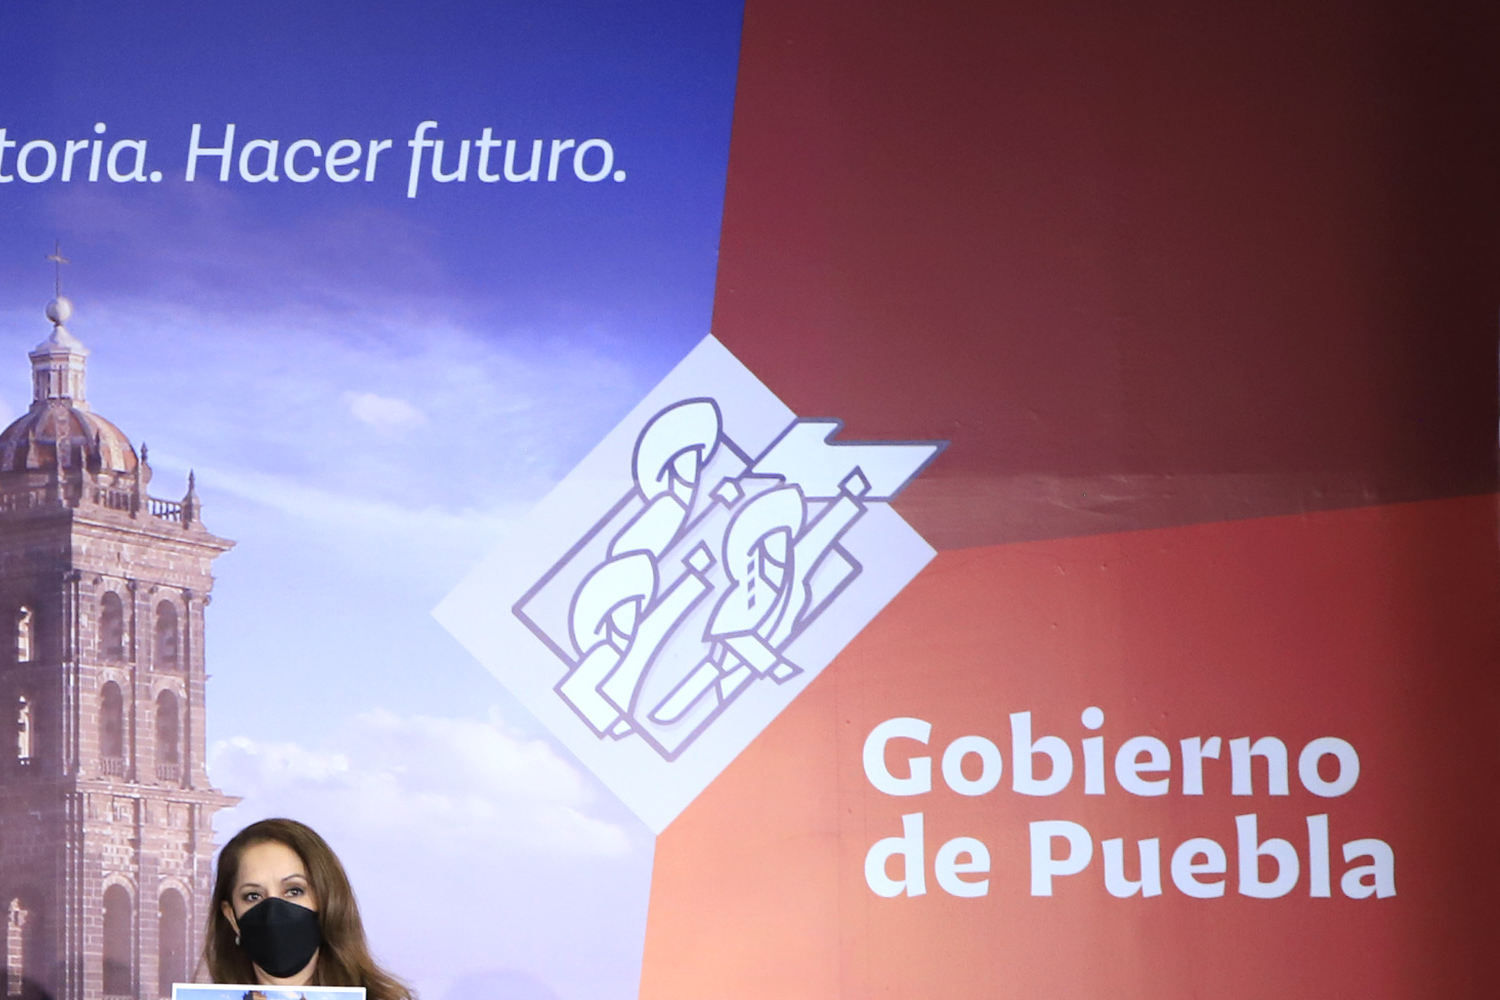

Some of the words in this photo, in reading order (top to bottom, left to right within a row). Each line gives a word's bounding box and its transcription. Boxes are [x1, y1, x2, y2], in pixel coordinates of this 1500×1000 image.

[185, 124, 392, 182] Hacer
[407, 121, 626, 198] futuro.
[862, 706, 1360, 798] Gobierno
[864, 812, 990, 898] de
[1028, 814, 1396, 899] Puebla
